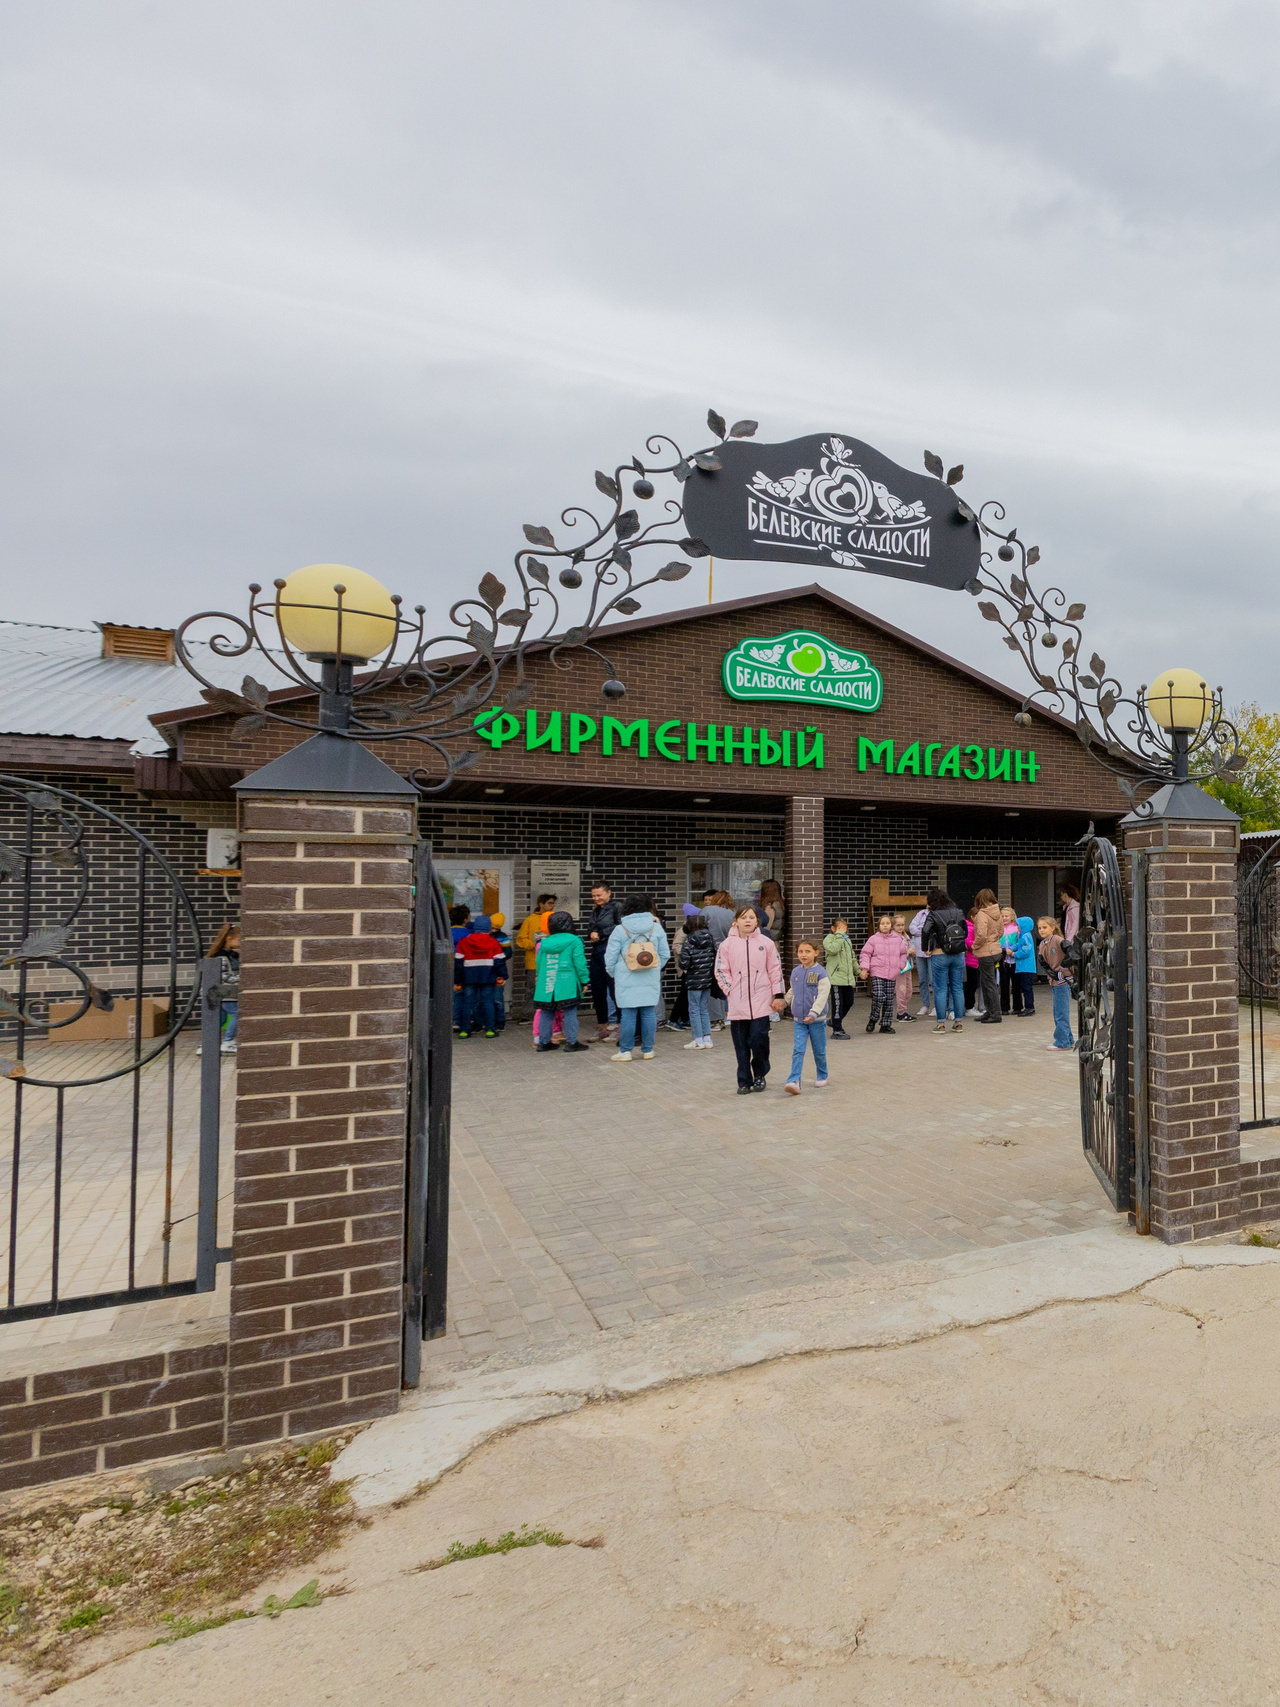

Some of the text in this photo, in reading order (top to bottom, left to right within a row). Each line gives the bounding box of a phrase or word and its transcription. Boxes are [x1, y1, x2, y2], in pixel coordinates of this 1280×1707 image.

[748, 497, 931, 558] БЕЛЕВСКИЕ СЛАДОСТИ
[736, 666, 872, 700] БЕЛЕВСКИЕ СЛАДОСТИ
[473, 706, 1041, 783] ФИРМЕННЫЙ МАГАЗИН
